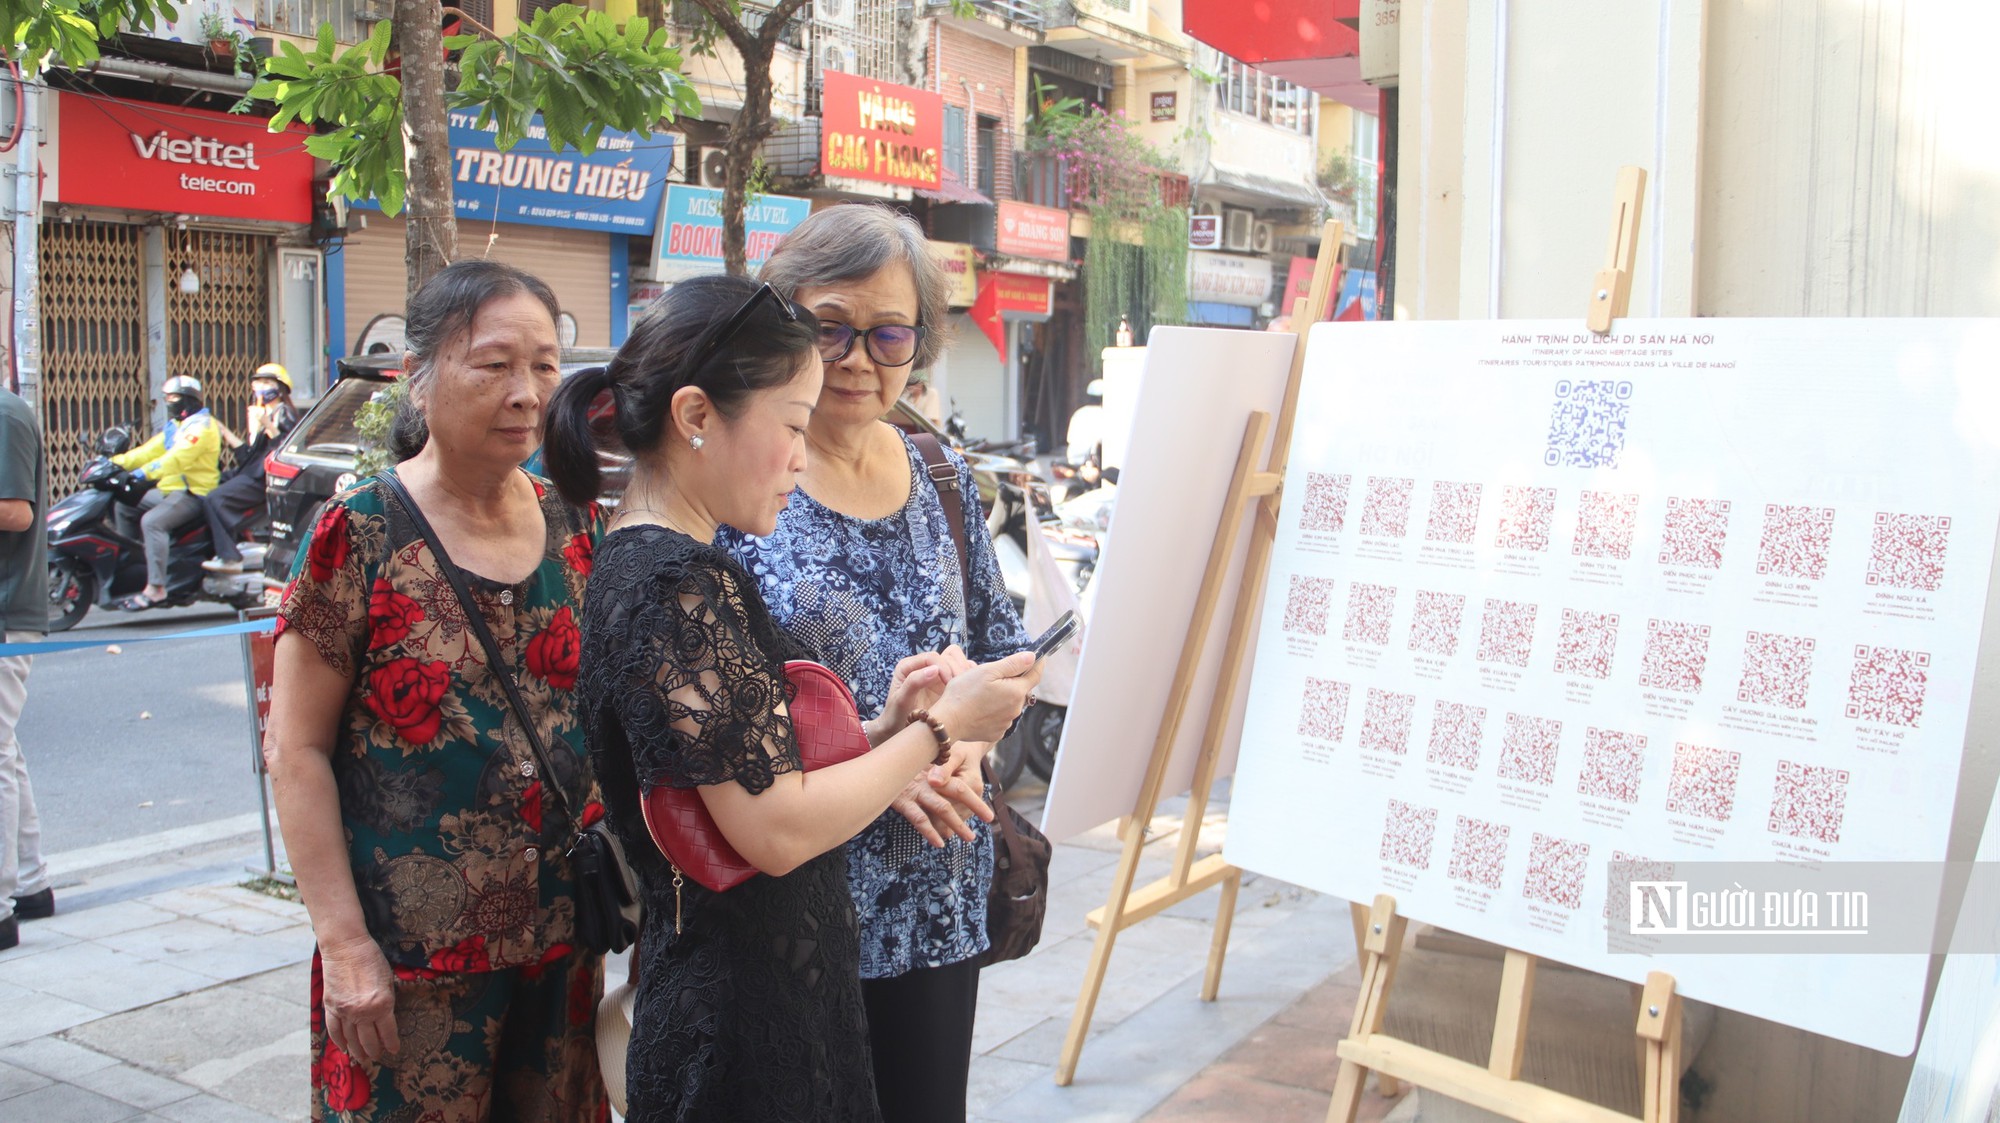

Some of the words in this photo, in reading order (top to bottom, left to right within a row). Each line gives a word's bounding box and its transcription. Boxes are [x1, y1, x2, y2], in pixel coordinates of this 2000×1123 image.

[130, 130, 260, 171] viettel
[828, 132, 869, 172] CAO
[873, 139, 937, 183] PHONG
[180, 172, 256, 196] telecom
[456, 148, 573, 194] TRUNG
[574, 157, 650, 202] HIẾU
[1523, 359, 1573, 367] TOURISTIQUES
[1575, 360, 1631, 368] PATRIMONIAUX
[1695, 361, 1707, 369] DE
[1532, 348, 1570, 356] ITINERARY
[1609, 349, 1648, 357] HERITAGE
[1650, 349, 1674, 357] SITES
